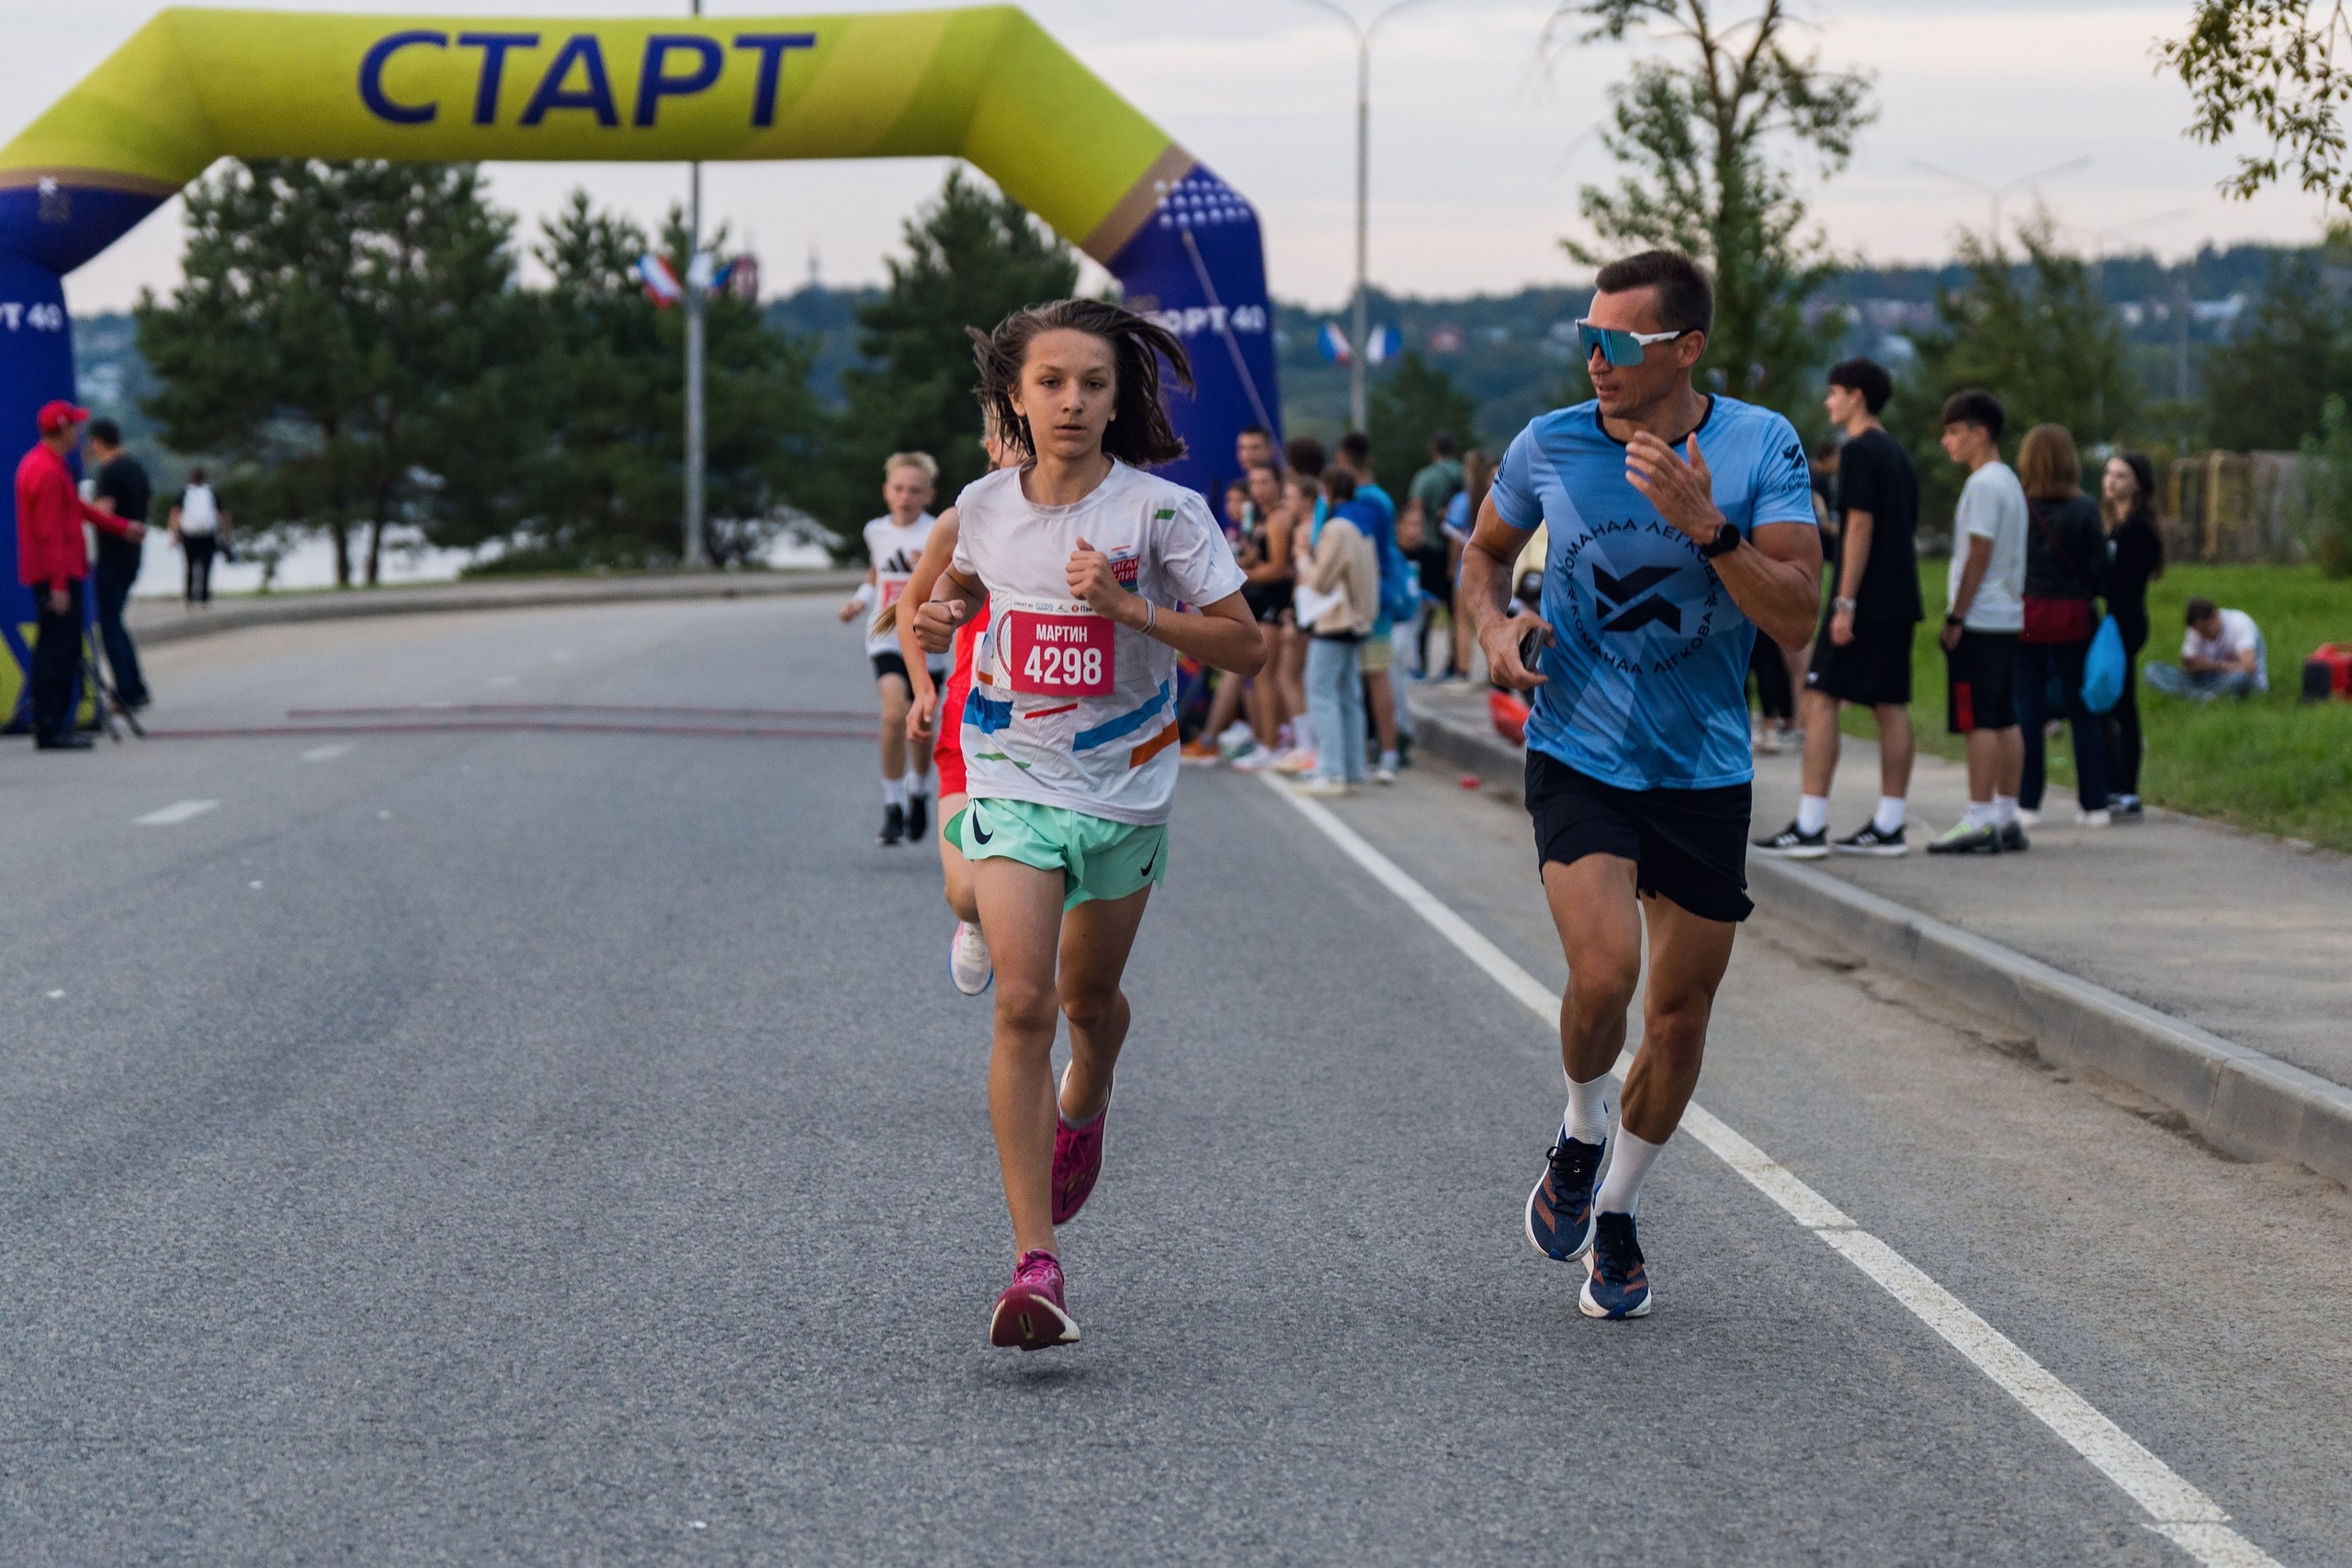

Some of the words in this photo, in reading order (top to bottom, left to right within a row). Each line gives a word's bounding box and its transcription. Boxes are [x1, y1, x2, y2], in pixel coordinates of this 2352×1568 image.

[358, 28, 817, 128] СТАРТ
[0, 301, 24, 332] Т
[1111, 558, 1138, 572] ИГАЯ
[1115, 570, 1137, 581] ЛИ!
[1035, 624, 1088, 642] МАРТИН
[1024, 645, 1102, 685] 4298
